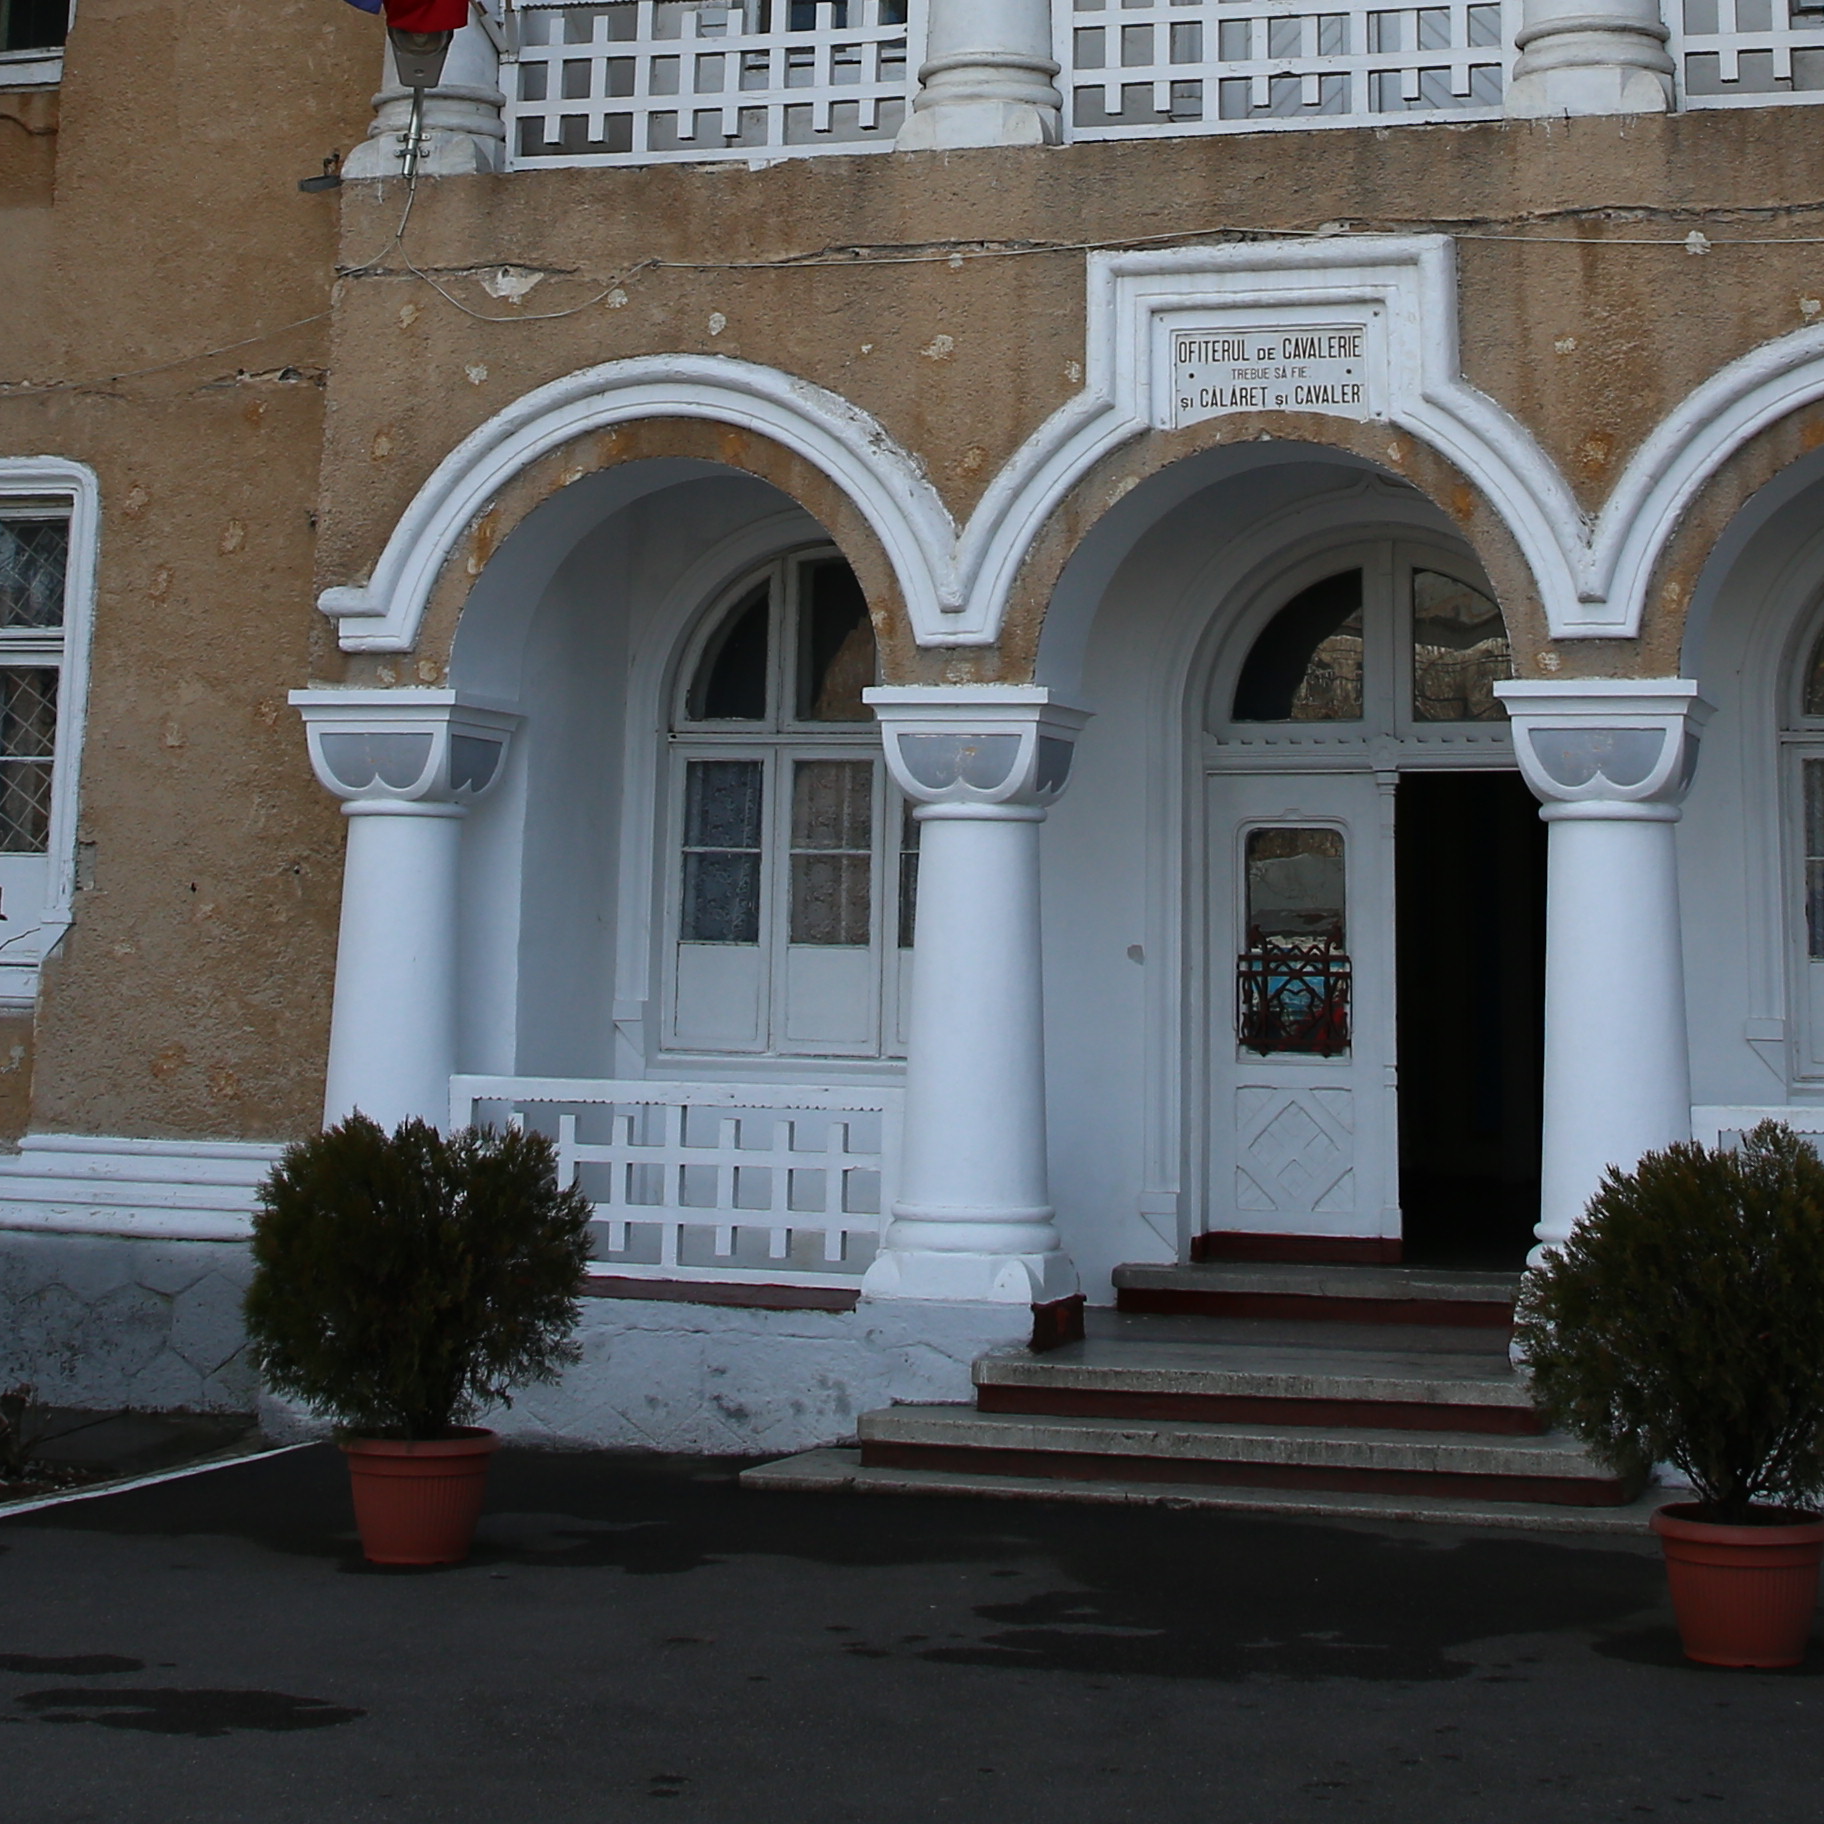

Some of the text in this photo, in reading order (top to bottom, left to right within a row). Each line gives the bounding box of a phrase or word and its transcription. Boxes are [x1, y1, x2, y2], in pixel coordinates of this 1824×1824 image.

[1256, 347, 1276, 361] DE
[1282, 335, 1362, 360] CAVALERIE
[1231, 366, 1270, 380] TREBUE
